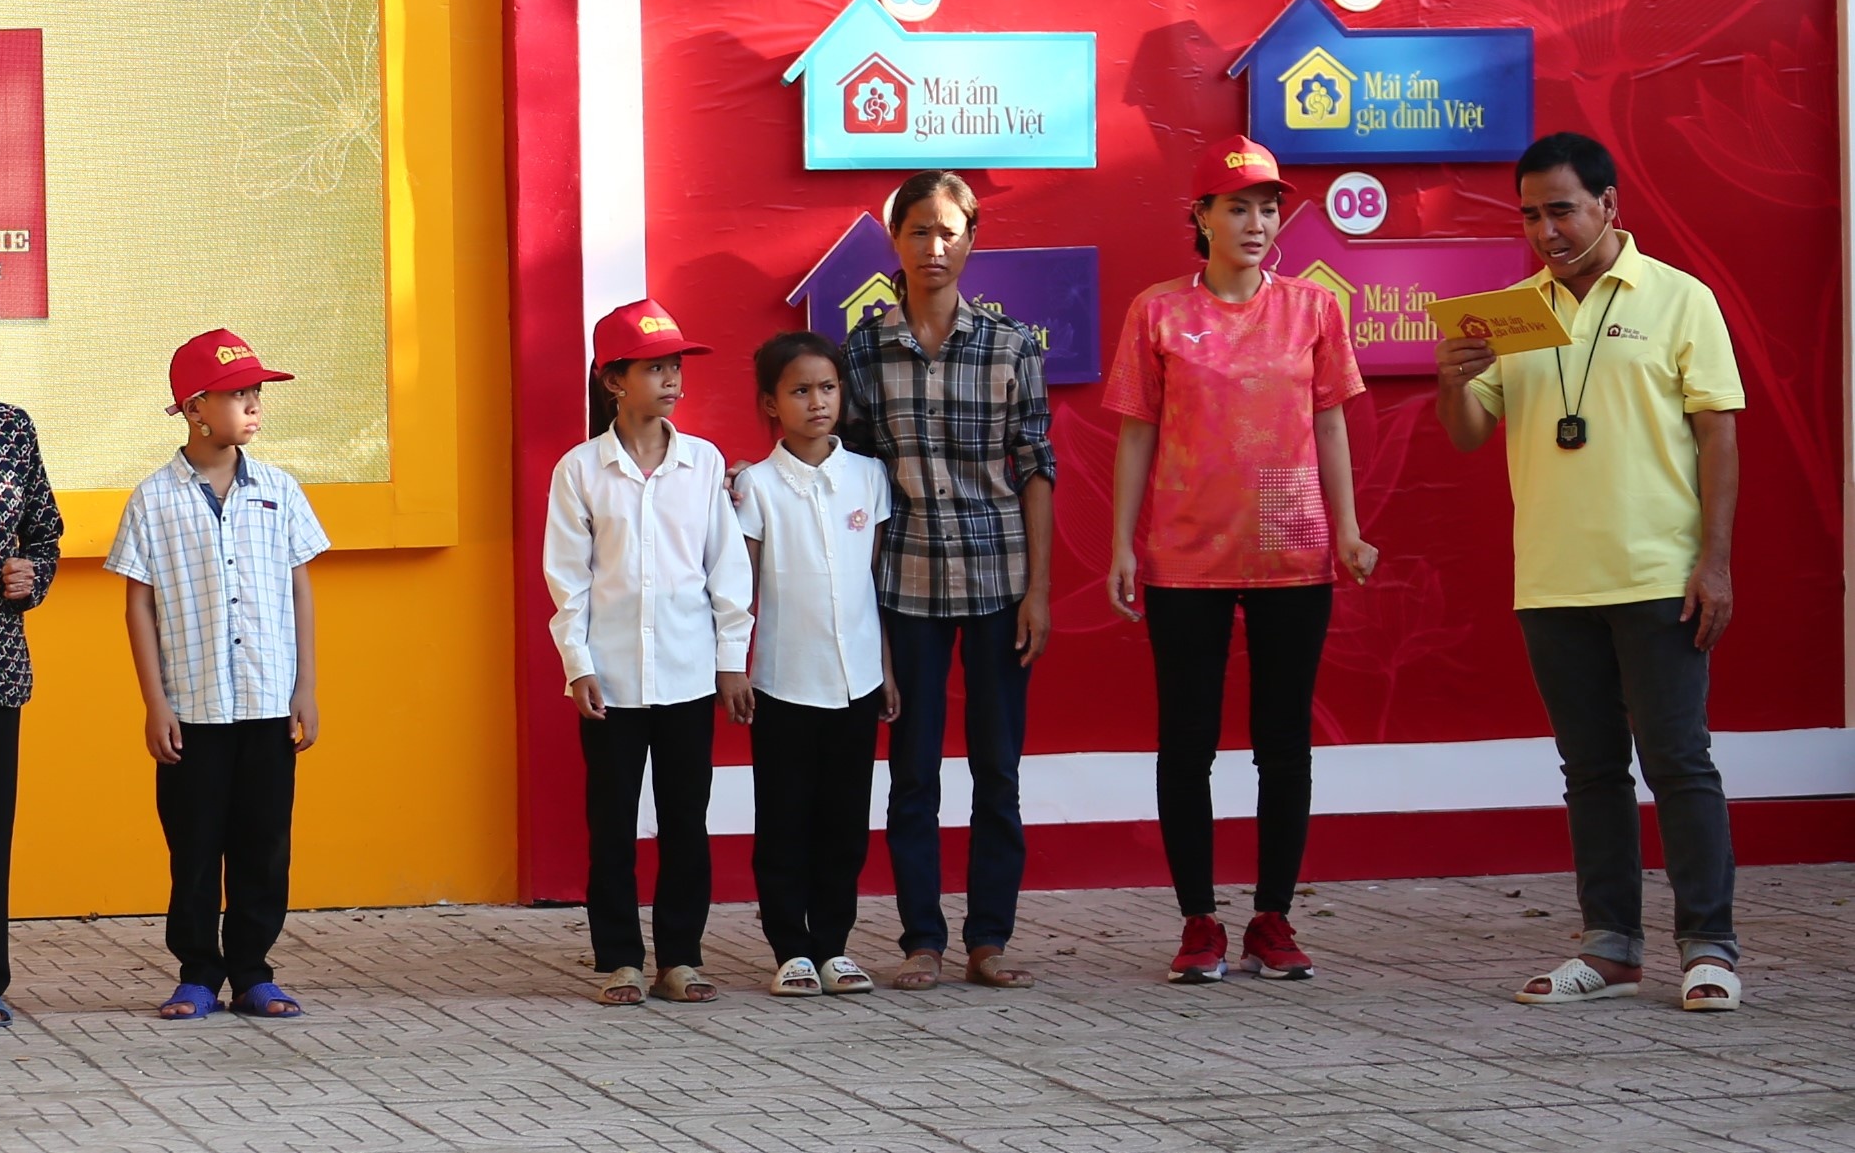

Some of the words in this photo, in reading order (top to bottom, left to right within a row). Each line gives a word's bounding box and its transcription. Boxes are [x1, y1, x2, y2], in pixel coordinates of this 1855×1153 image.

[922, 77, 960, 105] Mái
[965, 75, 999, 105] ấm
[1363, 70, 1401, 100] Mái
[1406, 69, 1440, 100] ấm
[914, 109, 946, 143] gia
[951, 106, 1000, 135] đình
[1004, 106, 1046, 139] Việt
[1355, 103, 1387, 137] gia
[1392, 99, 1441, 129] đình
[1443, 99, 1485, 133] Việt
[1334, 188, 1382, 219] 08
[1363, 283, 1400, 313] Mái
[1355, 316, 1385, 349] gia
[1391, 312, 1439, 341] đình
